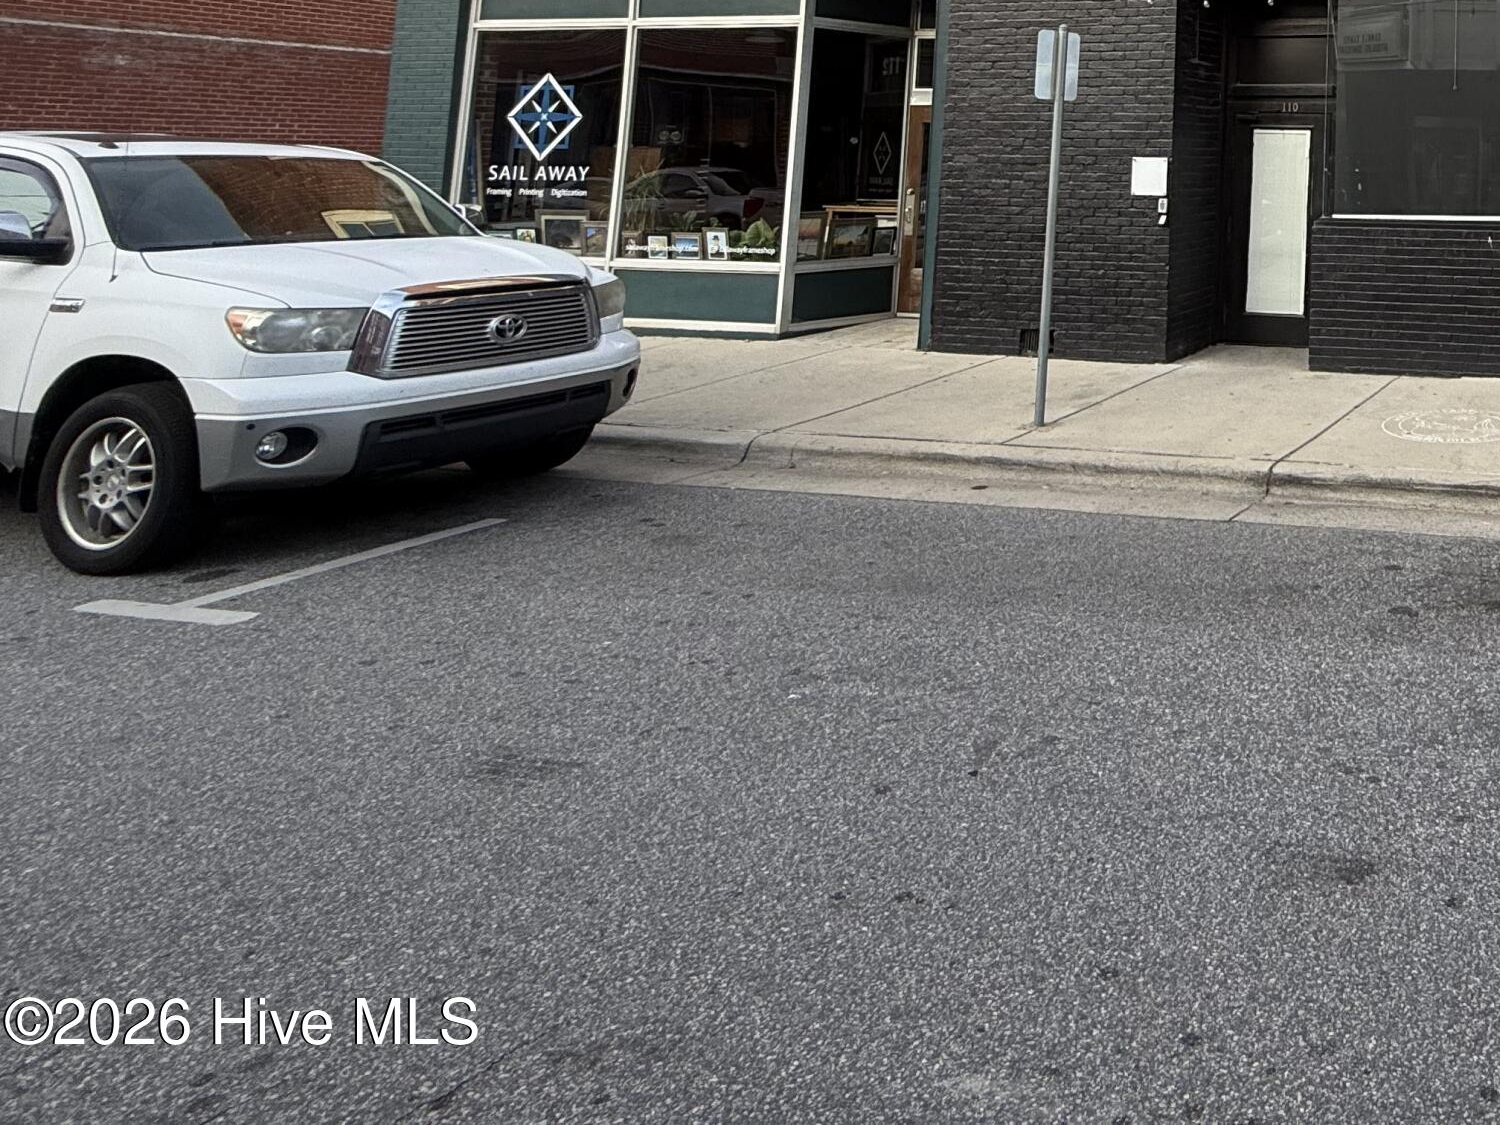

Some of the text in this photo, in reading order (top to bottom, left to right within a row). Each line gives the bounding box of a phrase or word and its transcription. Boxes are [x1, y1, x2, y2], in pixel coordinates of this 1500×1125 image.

[1282, 102, 1299, 112] 110
[488, 165, 590, 181] SAIL AWAY
[486, 187, 512, 197] Framing
[519, 188, 544, 198] Printing
